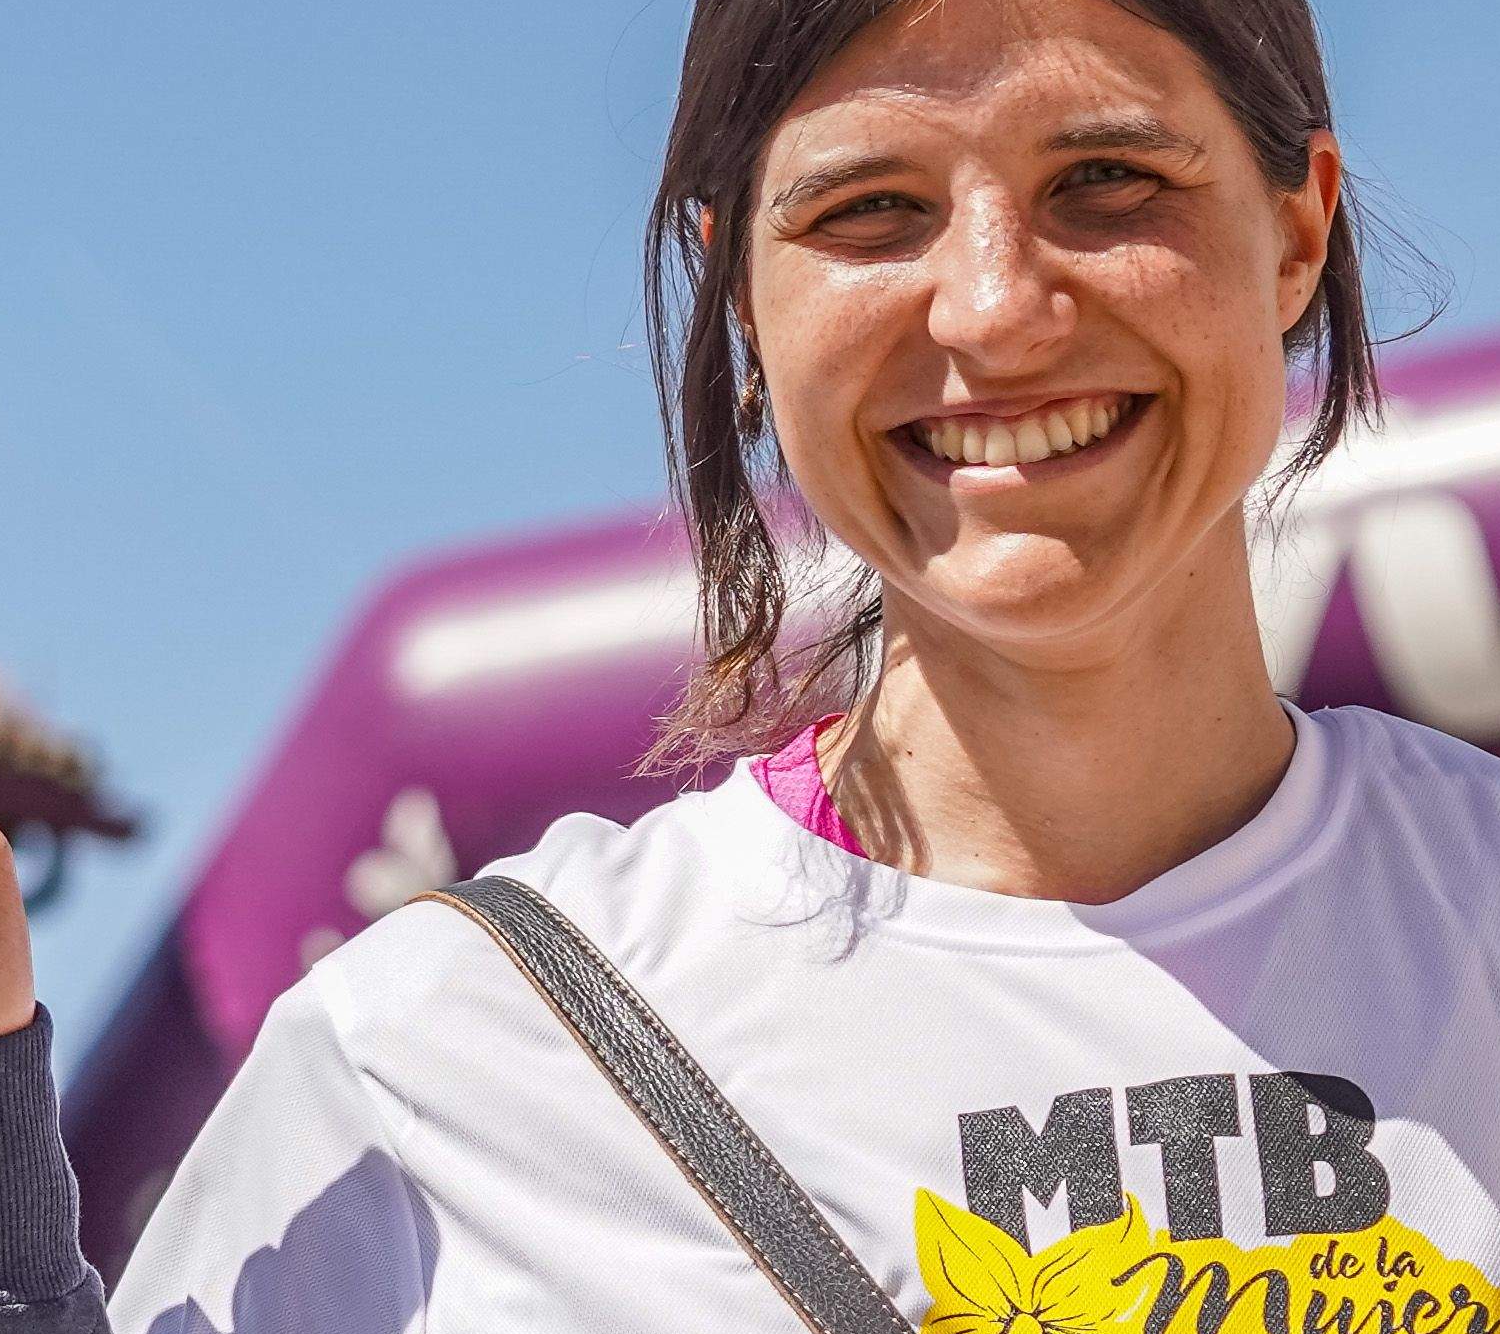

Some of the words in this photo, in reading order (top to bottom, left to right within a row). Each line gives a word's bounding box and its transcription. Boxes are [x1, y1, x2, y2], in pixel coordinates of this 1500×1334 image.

[957, 1070, 1391, 1257] MTB
[1309, 1239, 1362, 1281] de
[1376, 1236, 1425, 1281] la
